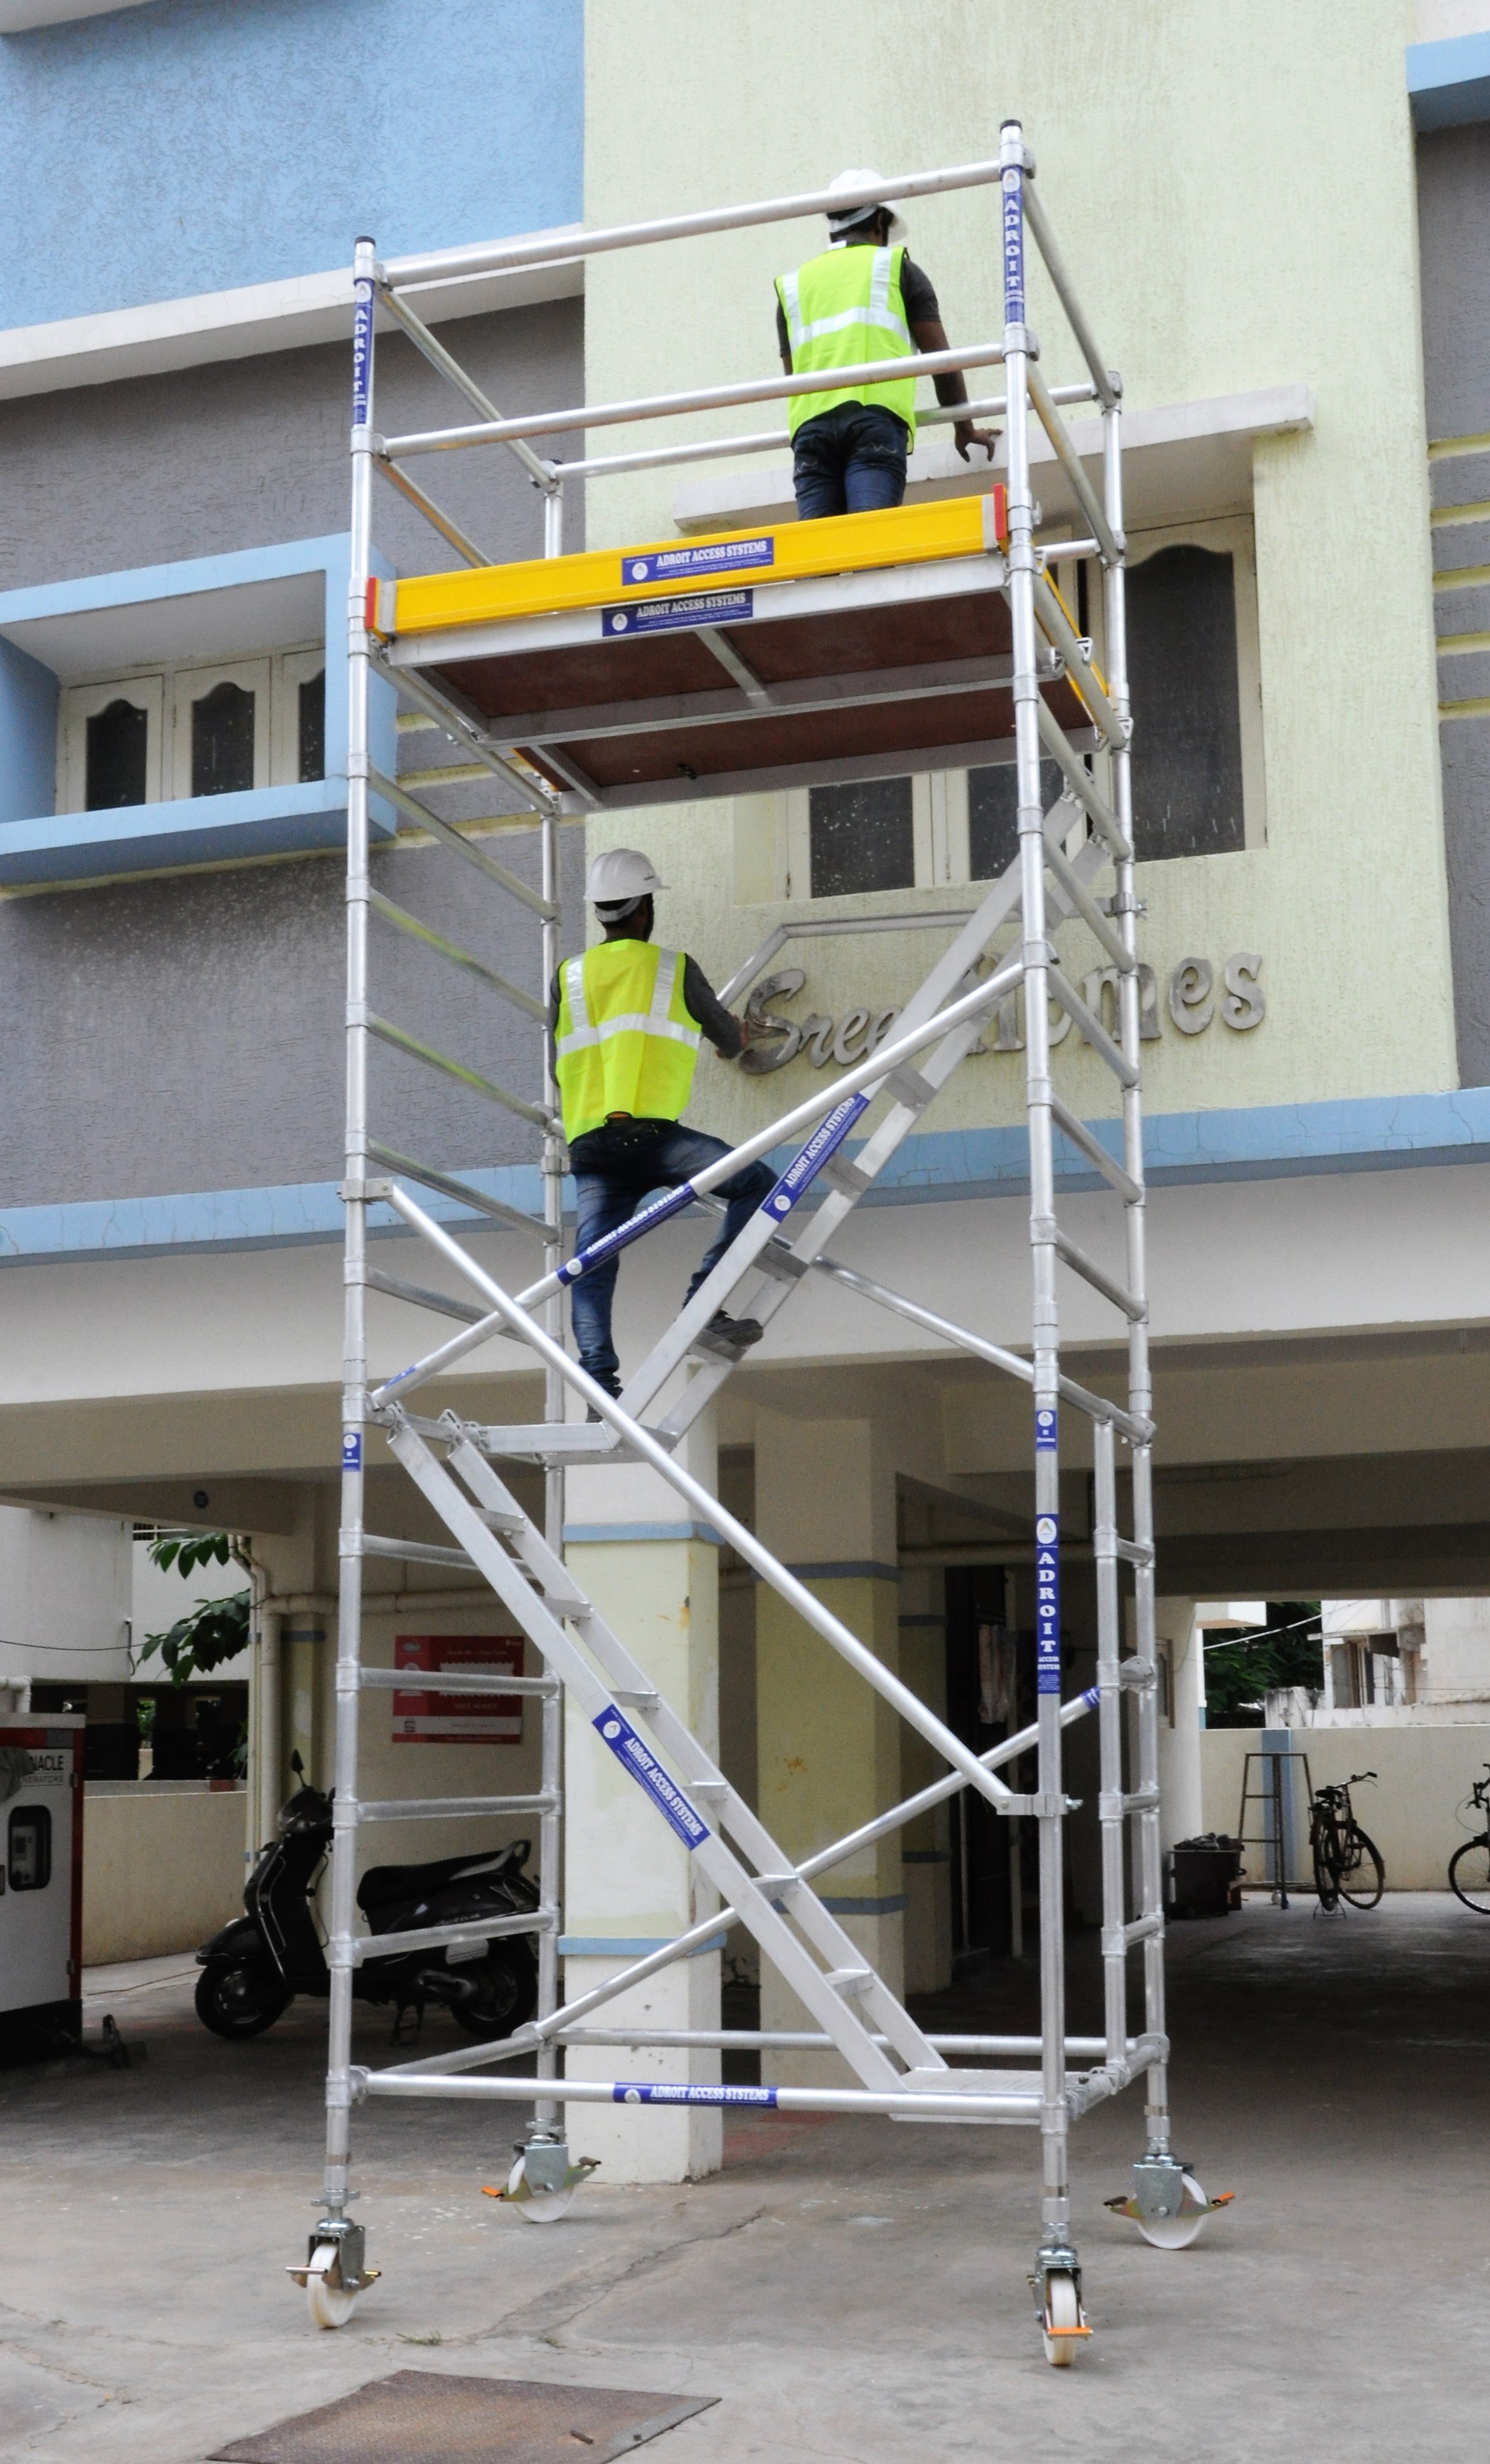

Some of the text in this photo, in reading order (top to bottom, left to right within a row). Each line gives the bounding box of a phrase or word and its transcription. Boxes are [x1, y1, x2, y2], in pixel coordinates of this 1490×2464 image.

[1004, 198, 1021, 287] ADROIT
[657, 540, 767, 568] ADROIT ACCESS SYSTEMS
[636, 592, 746, 618] ADROIT ACCESS SYSTEMS
[784, 1097, 855, 1189] ADROIT ACCESS SYSTEMS
[1038, 1552, 1056, 1653] ADROIT
[624, 1737, 703, 1836] ADROIT ACCESS SYSTEMS
[650, 2085, 769, 2101] ADROIT ACCESS SYSTEMS
